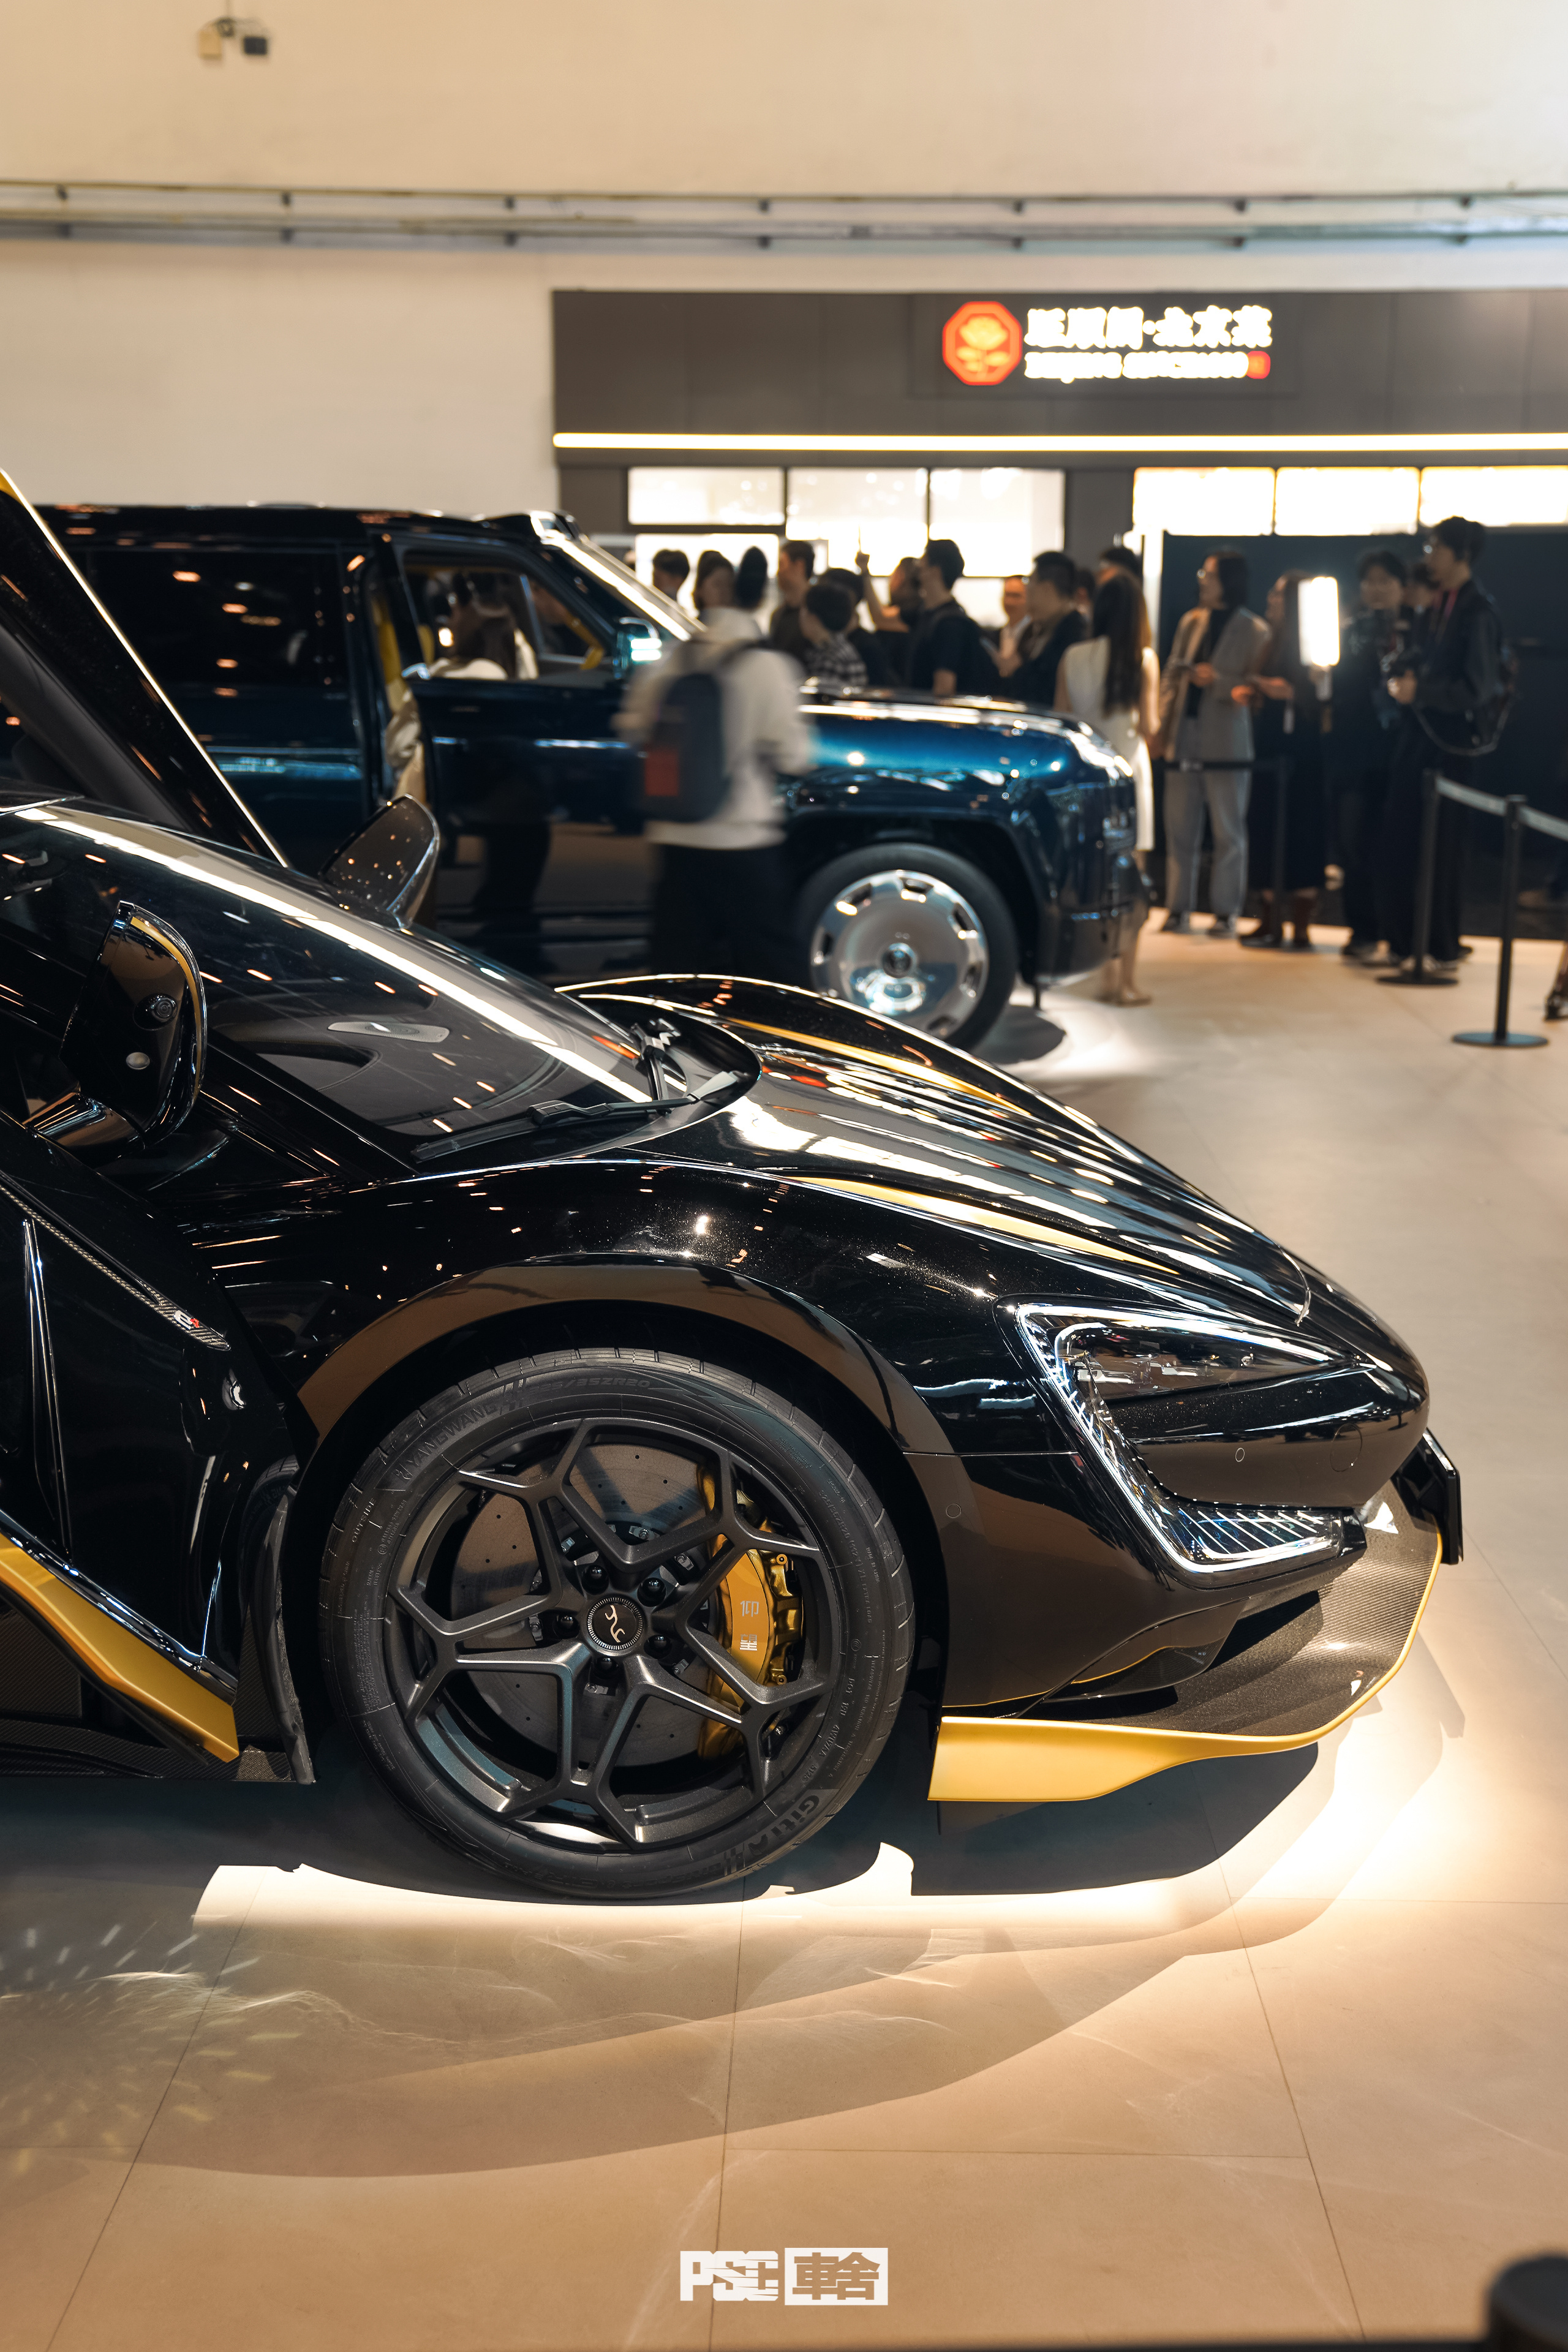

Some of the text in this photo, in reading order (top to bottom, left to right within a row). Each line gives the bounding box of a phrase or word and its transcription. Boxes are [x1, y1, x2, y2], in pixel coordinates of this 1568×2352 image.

[407, 1400, 496, 1468] YANGWANG
[352, 1498, 377, 1543] OUTSIDE
[858, 1569, 867, 1581] XL
[739, 1600, 760, 1651] 仰望
[845, 1678, 855, 1694] DOT
[771, 1793, 821, 1841] Giti
